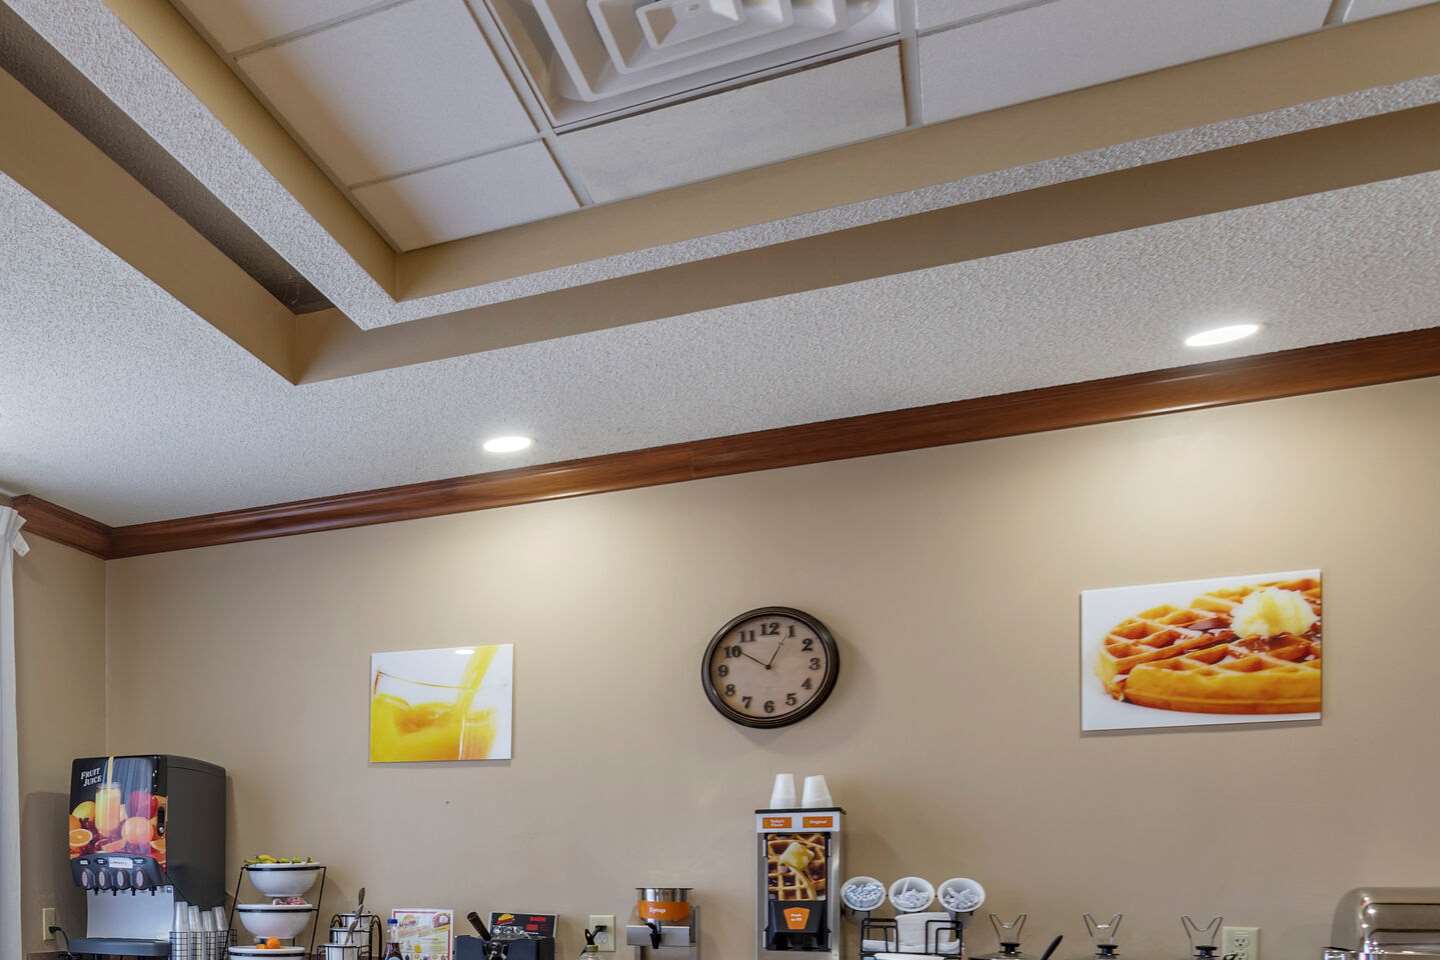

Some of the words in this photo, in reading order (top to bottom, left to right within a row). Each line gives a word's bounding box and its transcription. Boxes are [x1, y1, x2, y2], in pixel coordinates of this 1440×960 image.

[760, 622, 780, 636] 12
[788, 625, 796, 638] 1
[739, 630, 756, 643] 11
[724, 645, 742, 658] 10
[801, 638, 813, 652] 2
[809, 657, 821, 670] 3
[718, 664, 729, 677] 9
[725, 684, 736, 696] 8
[801, 678, 811, 690] 4
[742, 696, 753, 709] 7
[785, 693, 797, 706] 5
[763, 700, 775, 713] 6
[80, 767, 101, 780] FRUIT
[83, 775, 102, 787] JUICE
